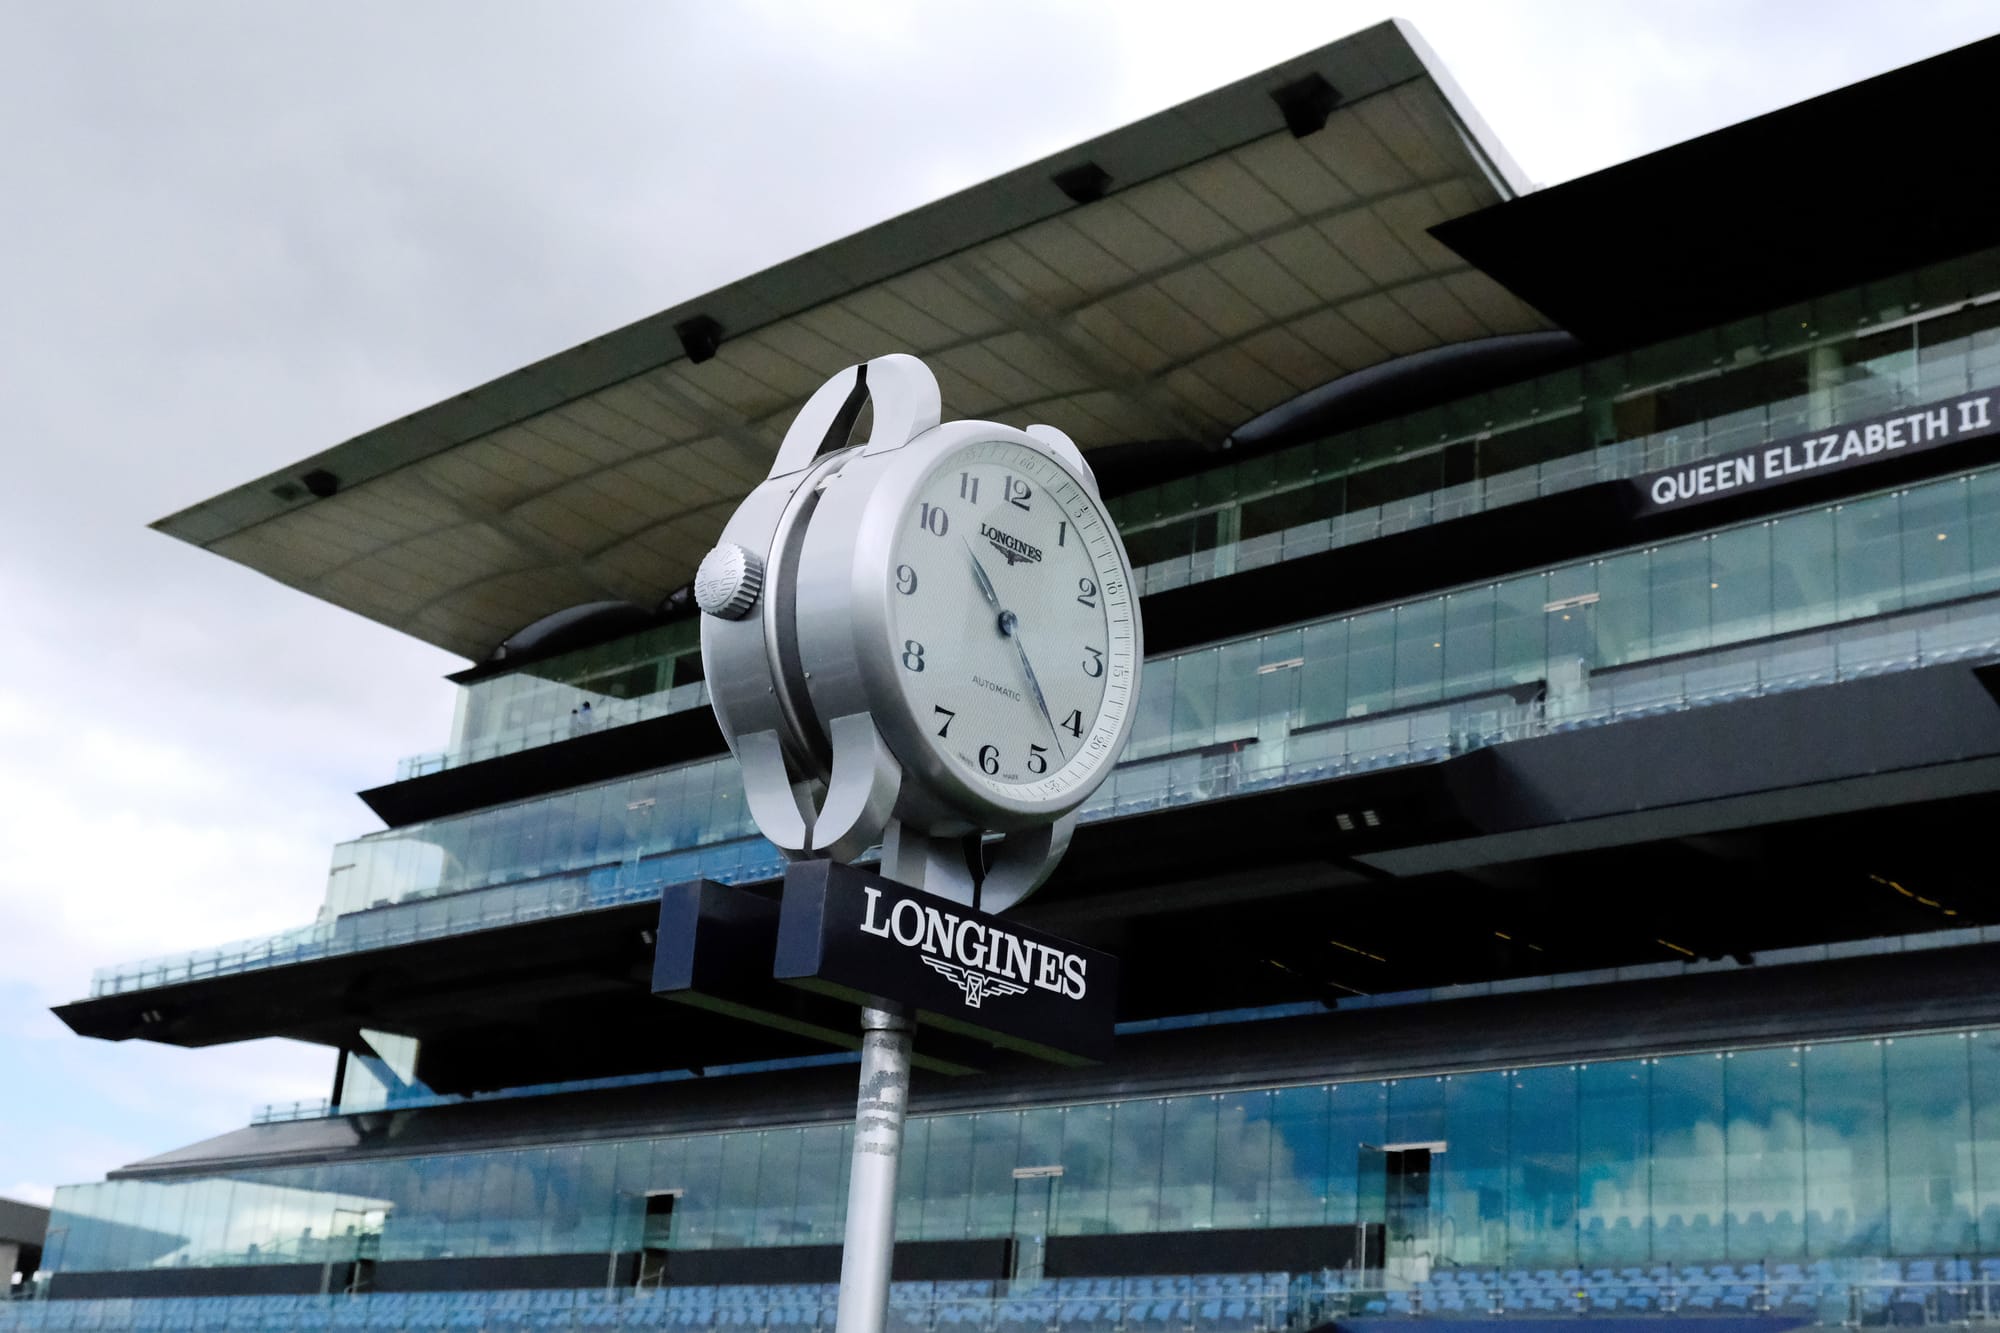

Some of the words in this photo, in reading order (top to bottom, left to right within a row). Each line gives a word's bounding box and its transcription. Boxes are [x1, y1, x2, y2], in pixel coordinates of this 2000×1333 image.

[1651, 455, 1755, 505] QUEEN
[1764, 406, 1950, 480] ELIZABETH
[1957, 396, 1991, 433] II
[959, 472, 980, 505] 11
[1004, 475, 1032, 511] 12
[920, 502, 949, 537] 10
[1058, 521, 1067, 547] 1
[980, 523, 1042, 562] LONGINES
[896, 564, 918, 595] 9
[1077, 577, 1097, 609] 2
[902, 640, 925, 672] 8
[1082, 646, 1104, 678] 3
[972, 675, 1021, 702] AUTOMATIC
[934, 704, 956, 738] 7
[1060, 709, 1084, 739] 4
[978, 744, 1000, 776] 6
[1027, 743, 1048, 774] 5
[860, 886, 1087, 1000] LONGINES
